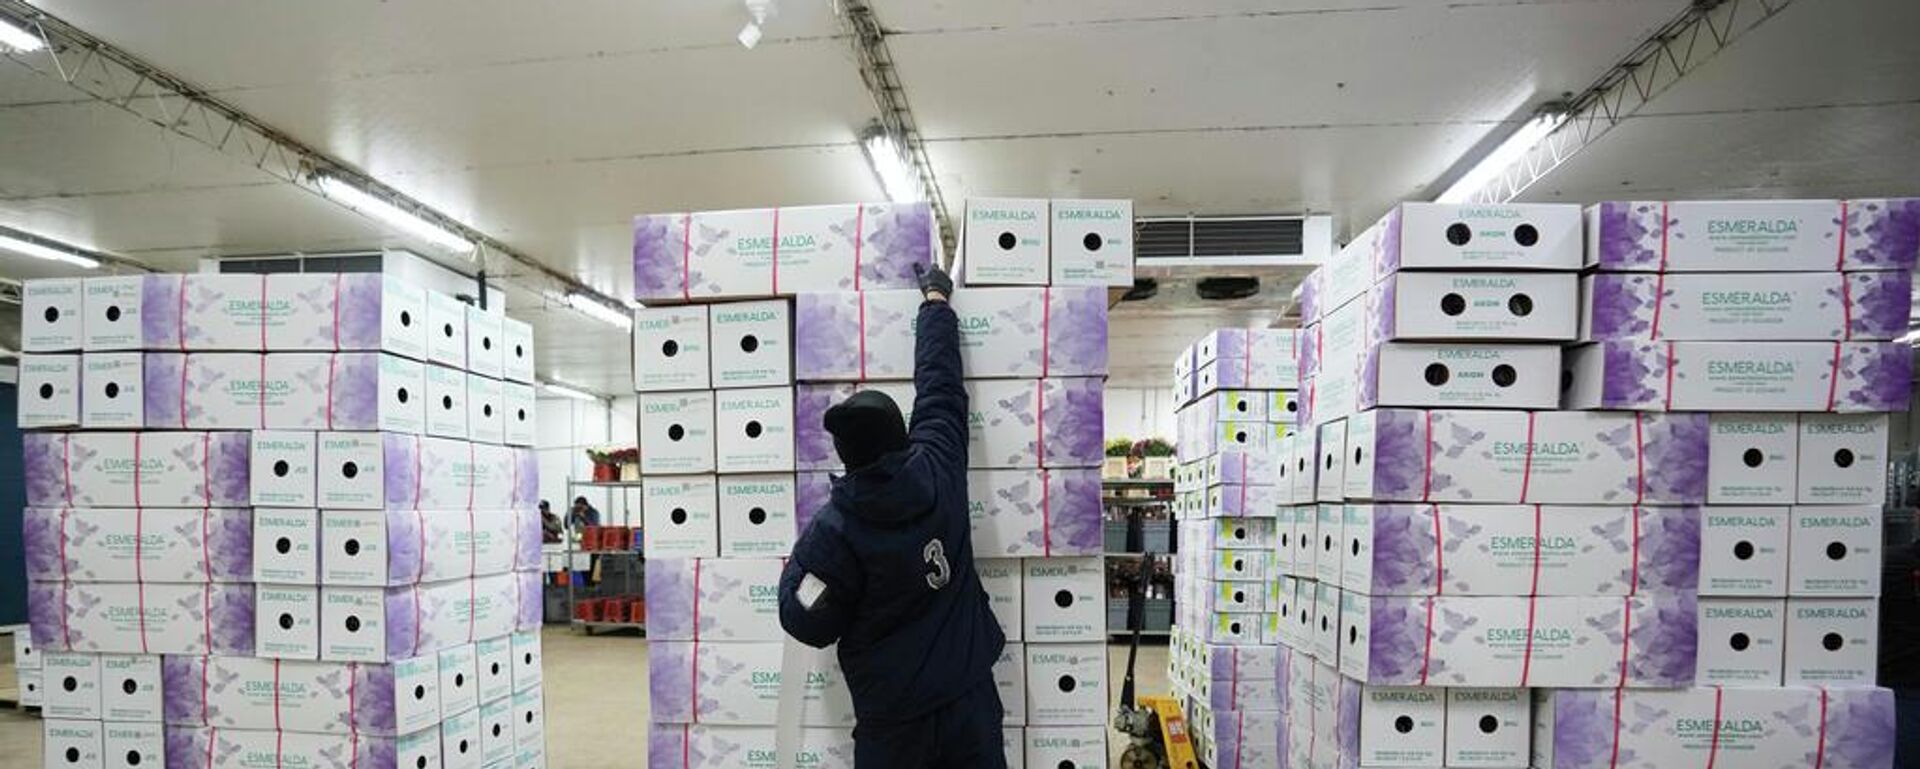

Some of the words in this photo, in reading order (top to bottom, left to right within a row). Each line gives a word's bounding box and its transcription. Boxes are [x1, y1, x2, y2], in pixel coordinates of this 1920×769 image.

[972, 210, 1037, 221] ESMERALDA
[1058, 210, 1122, 220] ESMERALDA
[1708, 220, 1798, 233] ESMERALDA
[738, 235, 816, 250] ESMEALDA
[1453, 278, 1516, 288] ESMERALDA
[1702, 292, 1791, 305] ESMERALDA
[229, 300, 290, 310] ESMEALDA
[717, 311, 777, 323] ESMERALDA
[639, 320, 669, 330] ESMER
[1708, 361, 1794, 374] ESMERALDA
[231, 381, 289, 390] ESMEALDA
[721, 400, 781, 411] ESMERALDA
[1718, 424, 1784, 434] ESMERALDA
[1808, 424, 1875, 434] ESMERALDA
[1494, 442, 1580, 455] ESMERALDA
[727, 484, 786, 495] ESMERALDA
[1709, 516, 1775, 527] ESMERALDA
[1801, 517, 1871, 528] ESMERALDA
[1491, 537, 1575, 549] ESMERALDA
[923, 539, 950, 589] 3
[1706, 608, 1773, 619] ESMERALDA
[1798, 608, 1868, 619] ESMERALDA
[1372, 692, 1435, 702] ESMERALDA
[1455, 692, 1518, 702] ESMERALDA
[248, 753, 308, 765] ESMEALDA
